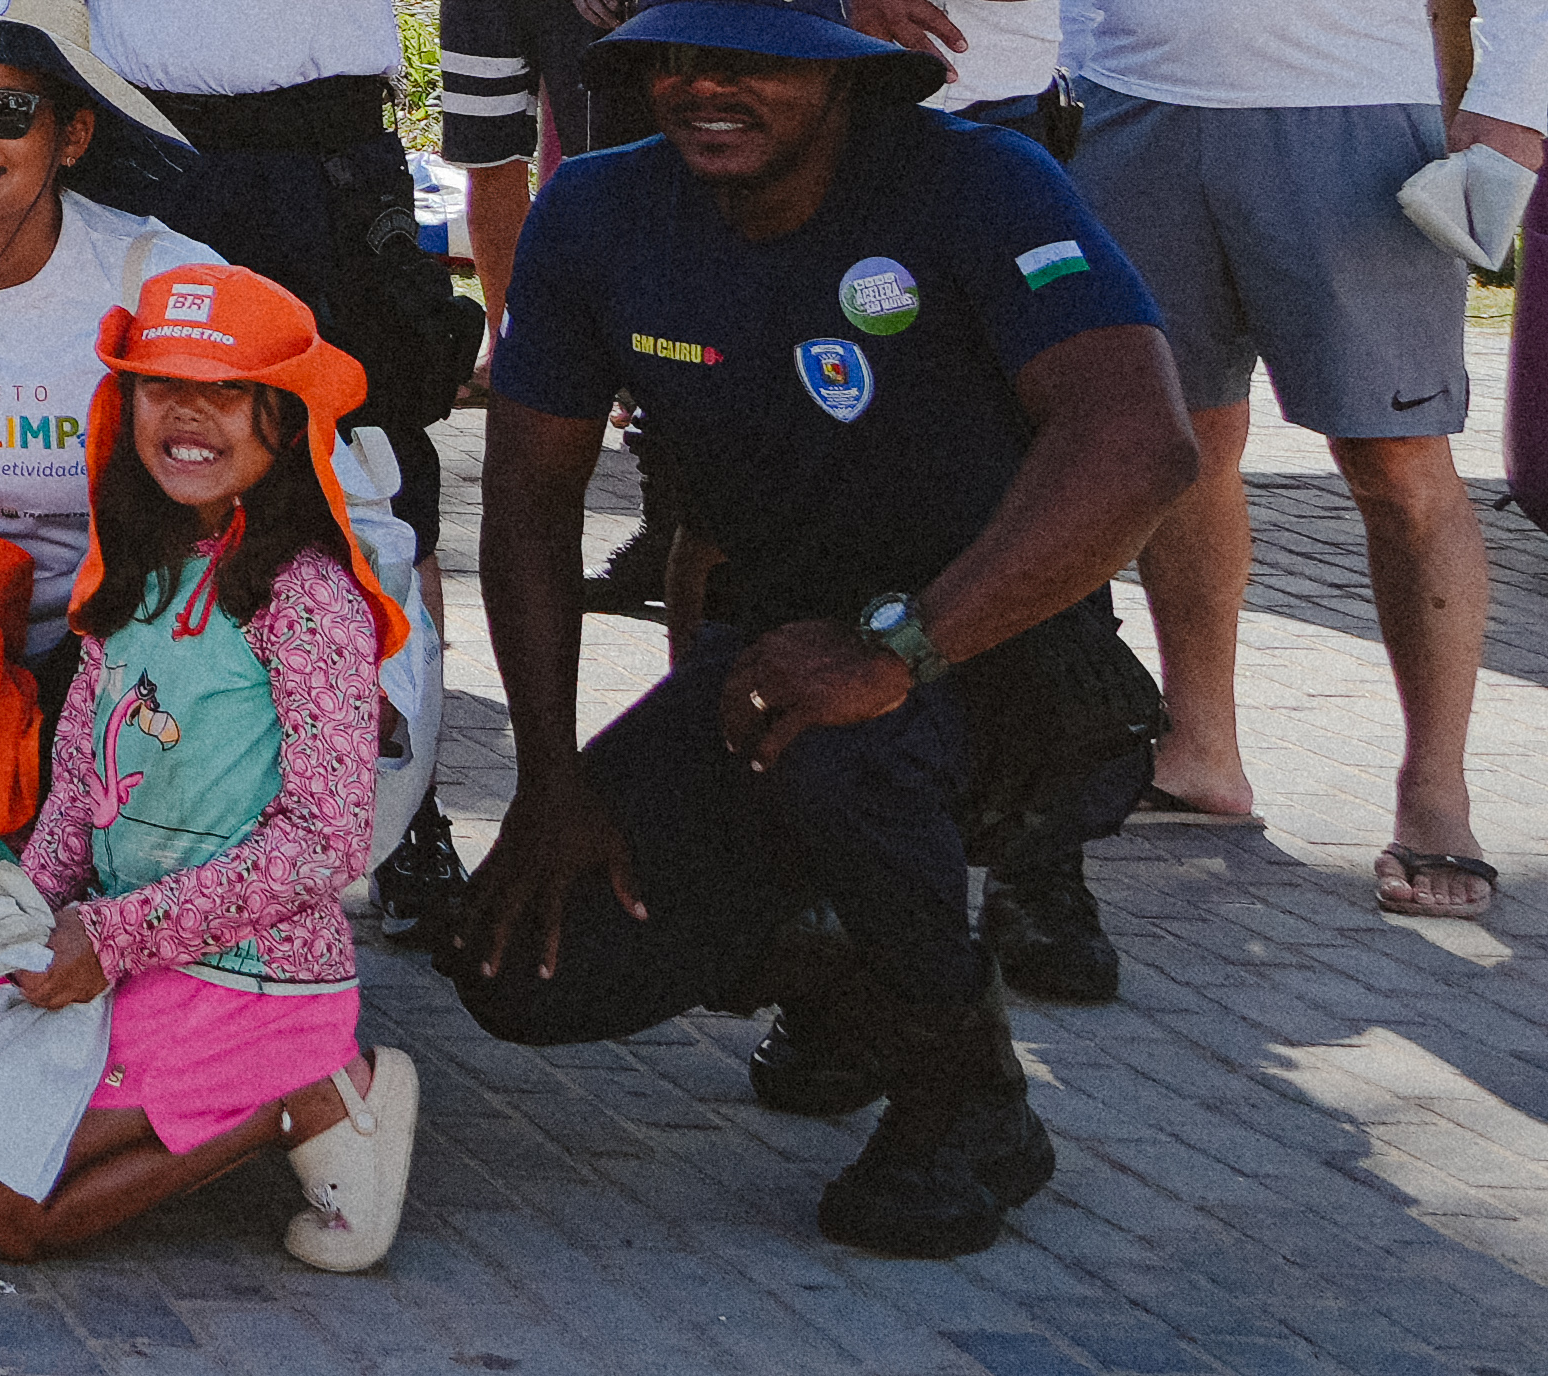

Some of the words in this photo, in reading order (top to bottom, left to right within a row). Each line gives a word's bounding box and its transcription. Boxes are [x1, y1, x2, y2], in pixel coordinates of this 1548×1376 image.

[142, 328, 234, 346] TRANSPETRO
[632, 333, 654, 354] GM
[657, 337, 702, 364] CAIRU
